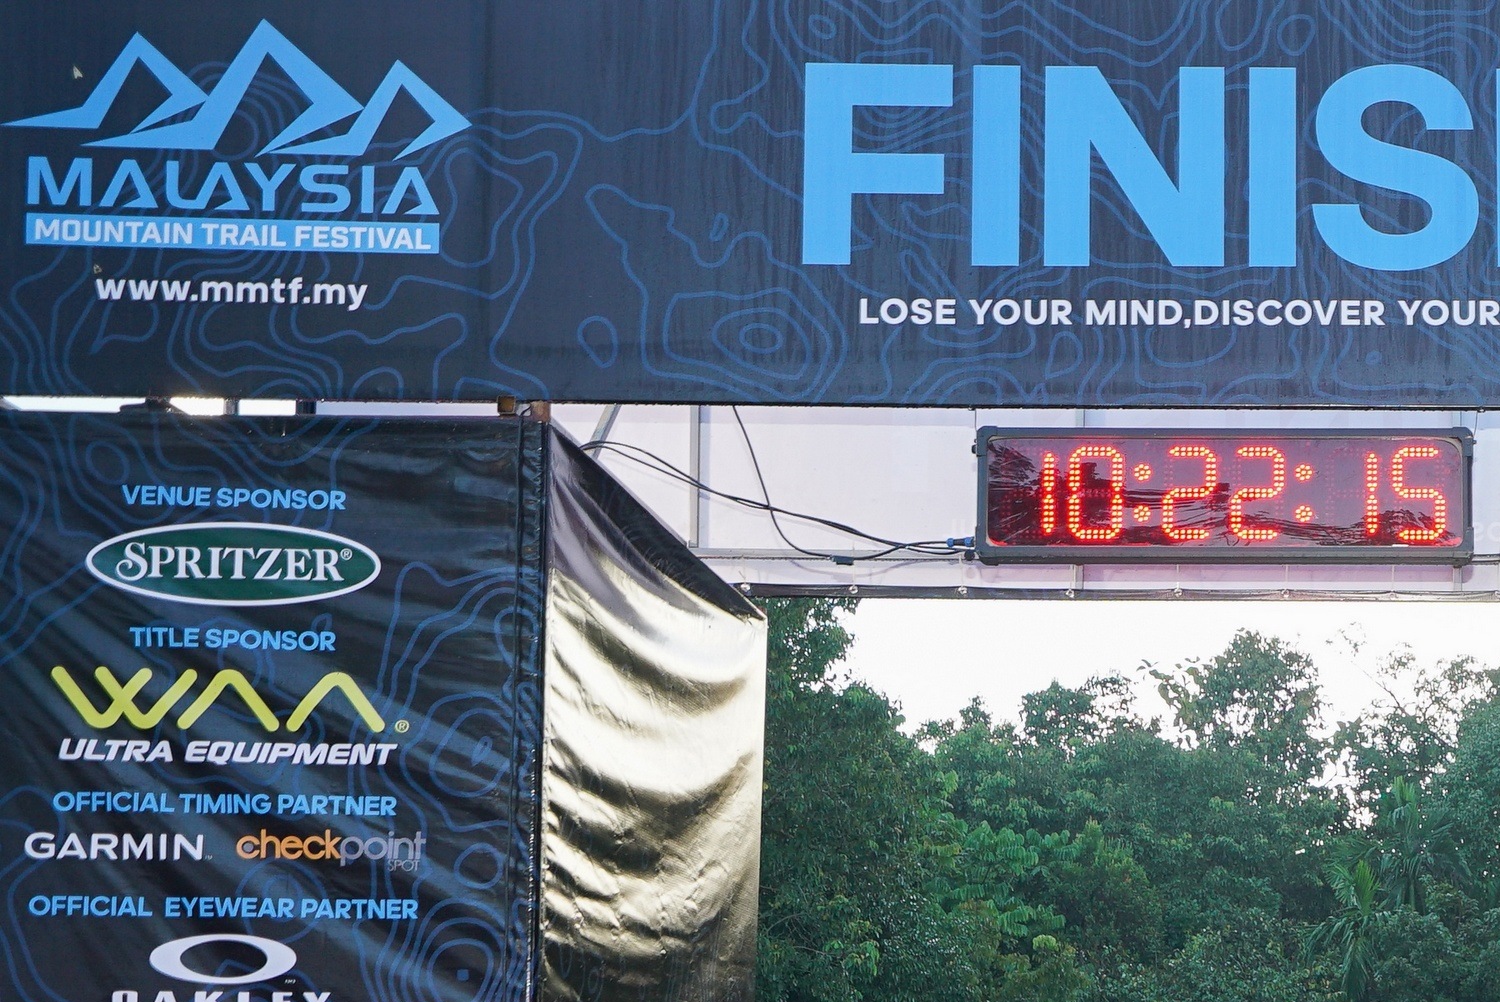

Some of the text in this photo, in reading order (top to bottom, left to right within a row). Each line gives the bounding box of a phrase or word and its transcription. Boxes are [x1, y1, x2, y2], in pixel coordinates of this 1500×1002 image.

[27, 156, 440, 215] MALAYSIA
[35, 219, 431, 250] MOUNTAIN TRAIL FESTIVAL
[95, 277, 368, 311] www.mmtf.my
[859, 297, 956, 327] LOSE
[972, 299, 1072, 327] YOUR
[1085, 299, 1386, 331] MIND,DISCOVER
[1398, 300, 1500, 328] YOUR
[122, 484, 346, 510] VENUE SPONSOR
[1041, 445, 1448, 543] 10:22:15
[116, 542, 344, 582] SPRITZER
[129, 627, 336, 651] TITLE SPONSOR
[59, 738, 397, 766] ULTRA EQUIPMENT
[53, 791, 397, 816] OFFICIAL TIMING PARTNER
[24, 829, 427, 867] GARMIN checkpoint
[387, 859, 420, 872] SPOT
[28, 895, 418, 920] OFFICIAL EYEWEAR PARTNER
